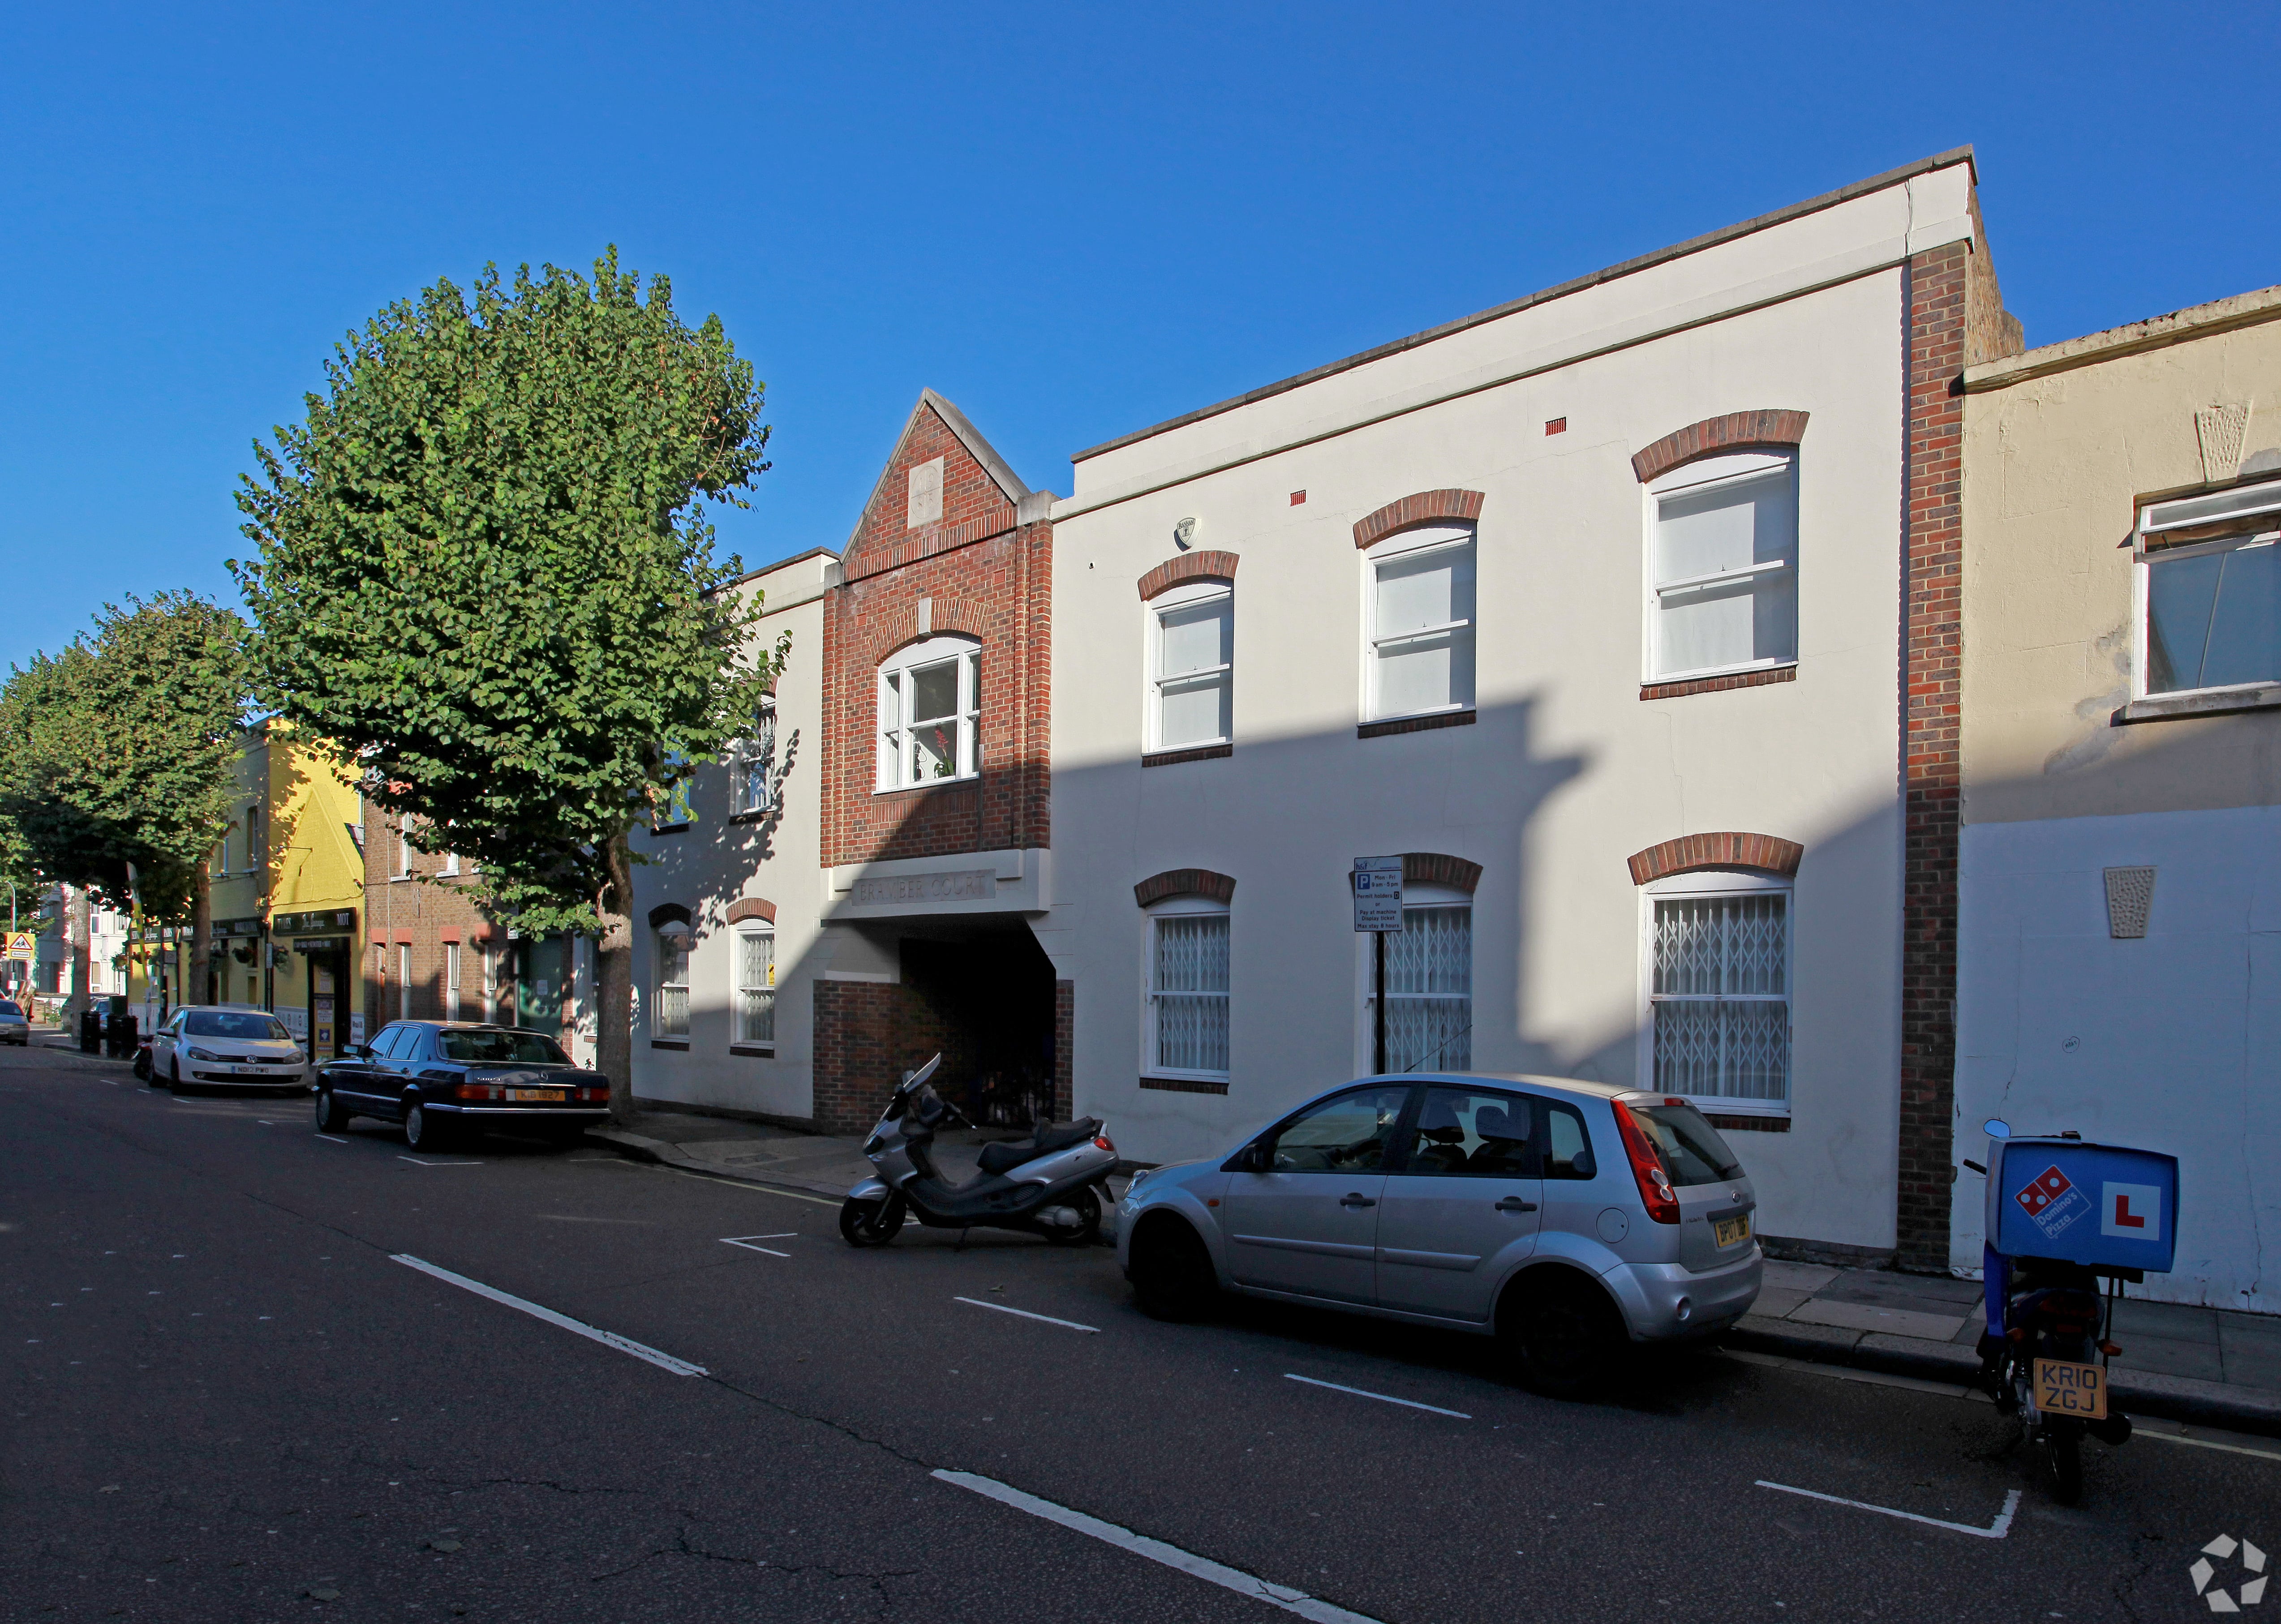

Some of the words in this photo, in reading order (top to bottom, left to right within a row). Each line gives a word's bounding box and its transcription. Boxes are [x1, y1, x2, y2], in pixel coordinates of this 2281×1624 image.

[1356, 862, 1368, 870] h&f
[860, 880, 924, 901] BRAMBER
[931, 875, 986, 896] COURT
[1360, 875, 1369, 889] P
[337, 913, 350, 926] MOT
[2036, 1192, 2078, 1226] Domino's
[2115, 1195, 2144, 1228] L
[2045, 1214, 2071, 1236] Pizza
[2042, 1364, 2097, 1390] KR10
[2045, 1386, 2095, 1412] ZGJ
